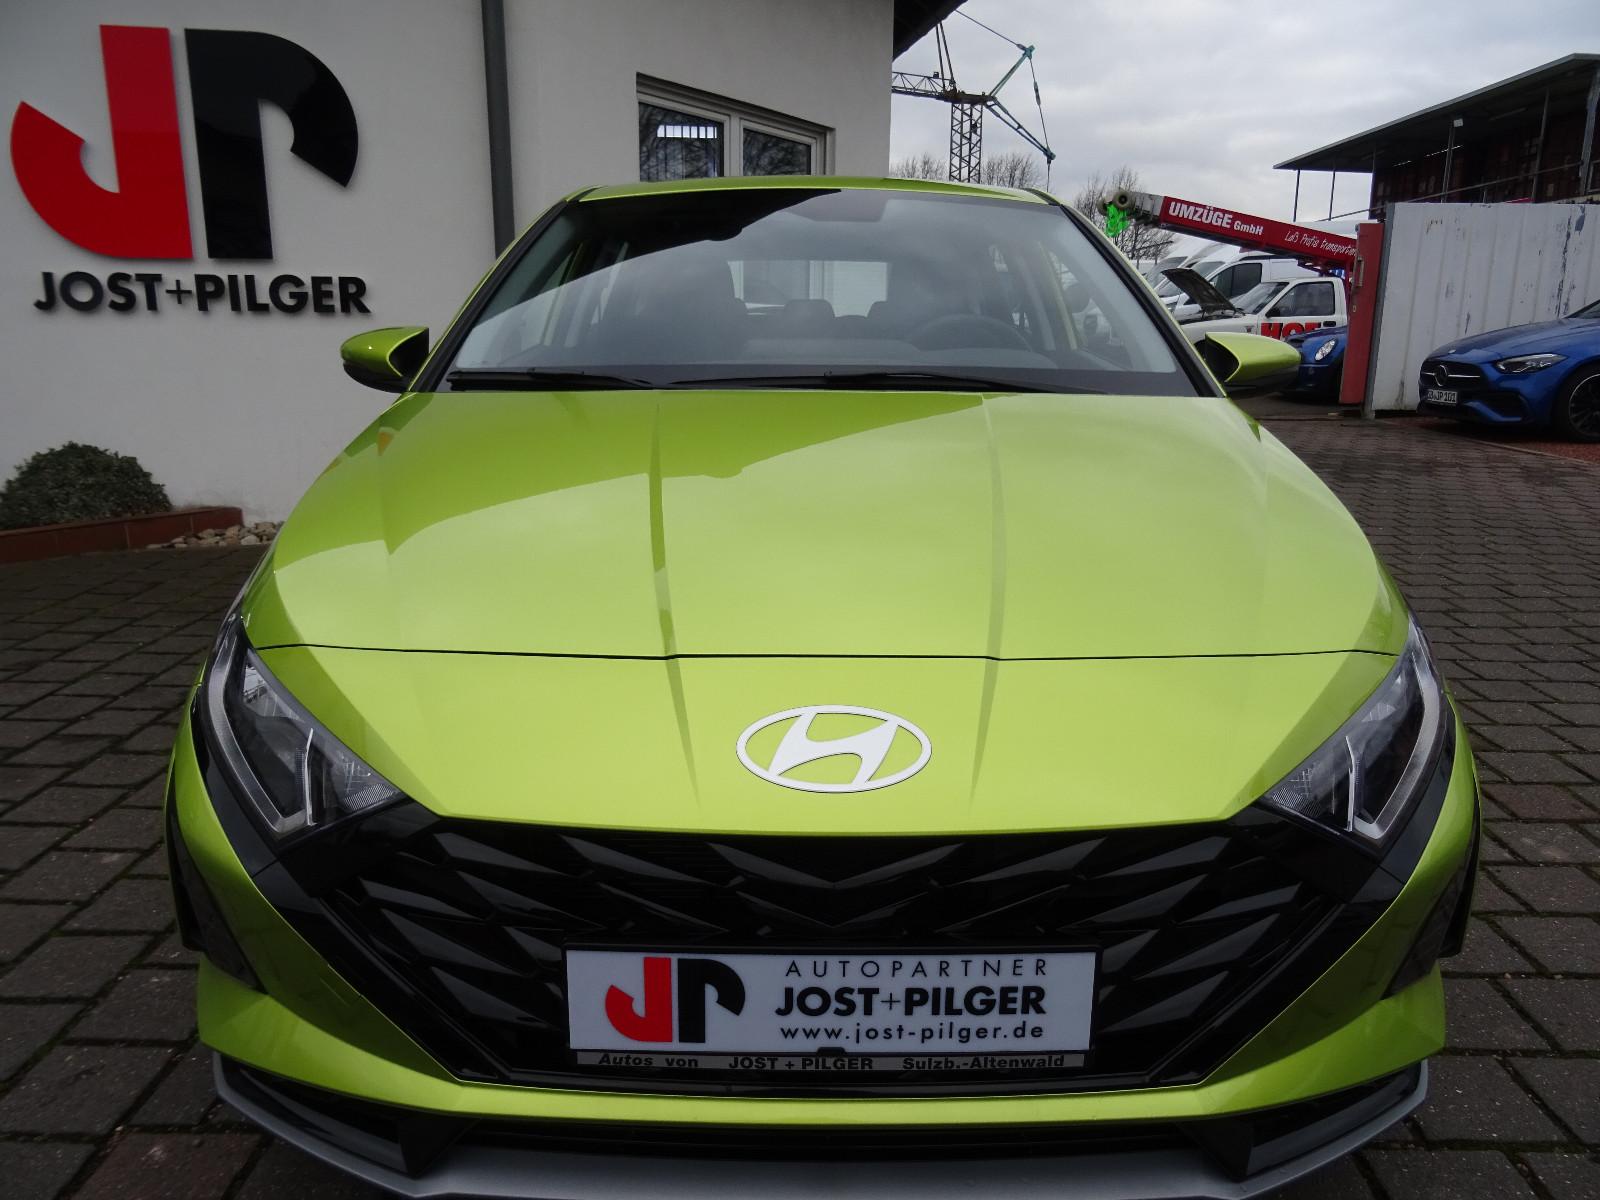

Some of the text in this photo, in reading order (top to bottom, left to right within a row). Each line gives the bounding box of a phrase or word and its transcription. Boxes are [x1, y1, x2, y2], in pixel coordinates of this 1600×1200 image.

[1168, 201, 1264, 236] UMZÜGE GmbH
[33, 271, 371, 313] JOST+PILGER
[785, 959, 1046, 978] AUTOPARTNER
[775, 986, 1047, 1017] JOST+PILGER
[780, 1020, 1044, 1044] www.jost-pilger.de
[598, 1053, 654, 1067] Autos
[665, 1056, 699, 1068] von
[729, 1056, 779, 1070] JOST
[801, 1057, 873, 1071] PILGER
[902, 1053, 1065, 1071] Sulzb.-Altenwald
